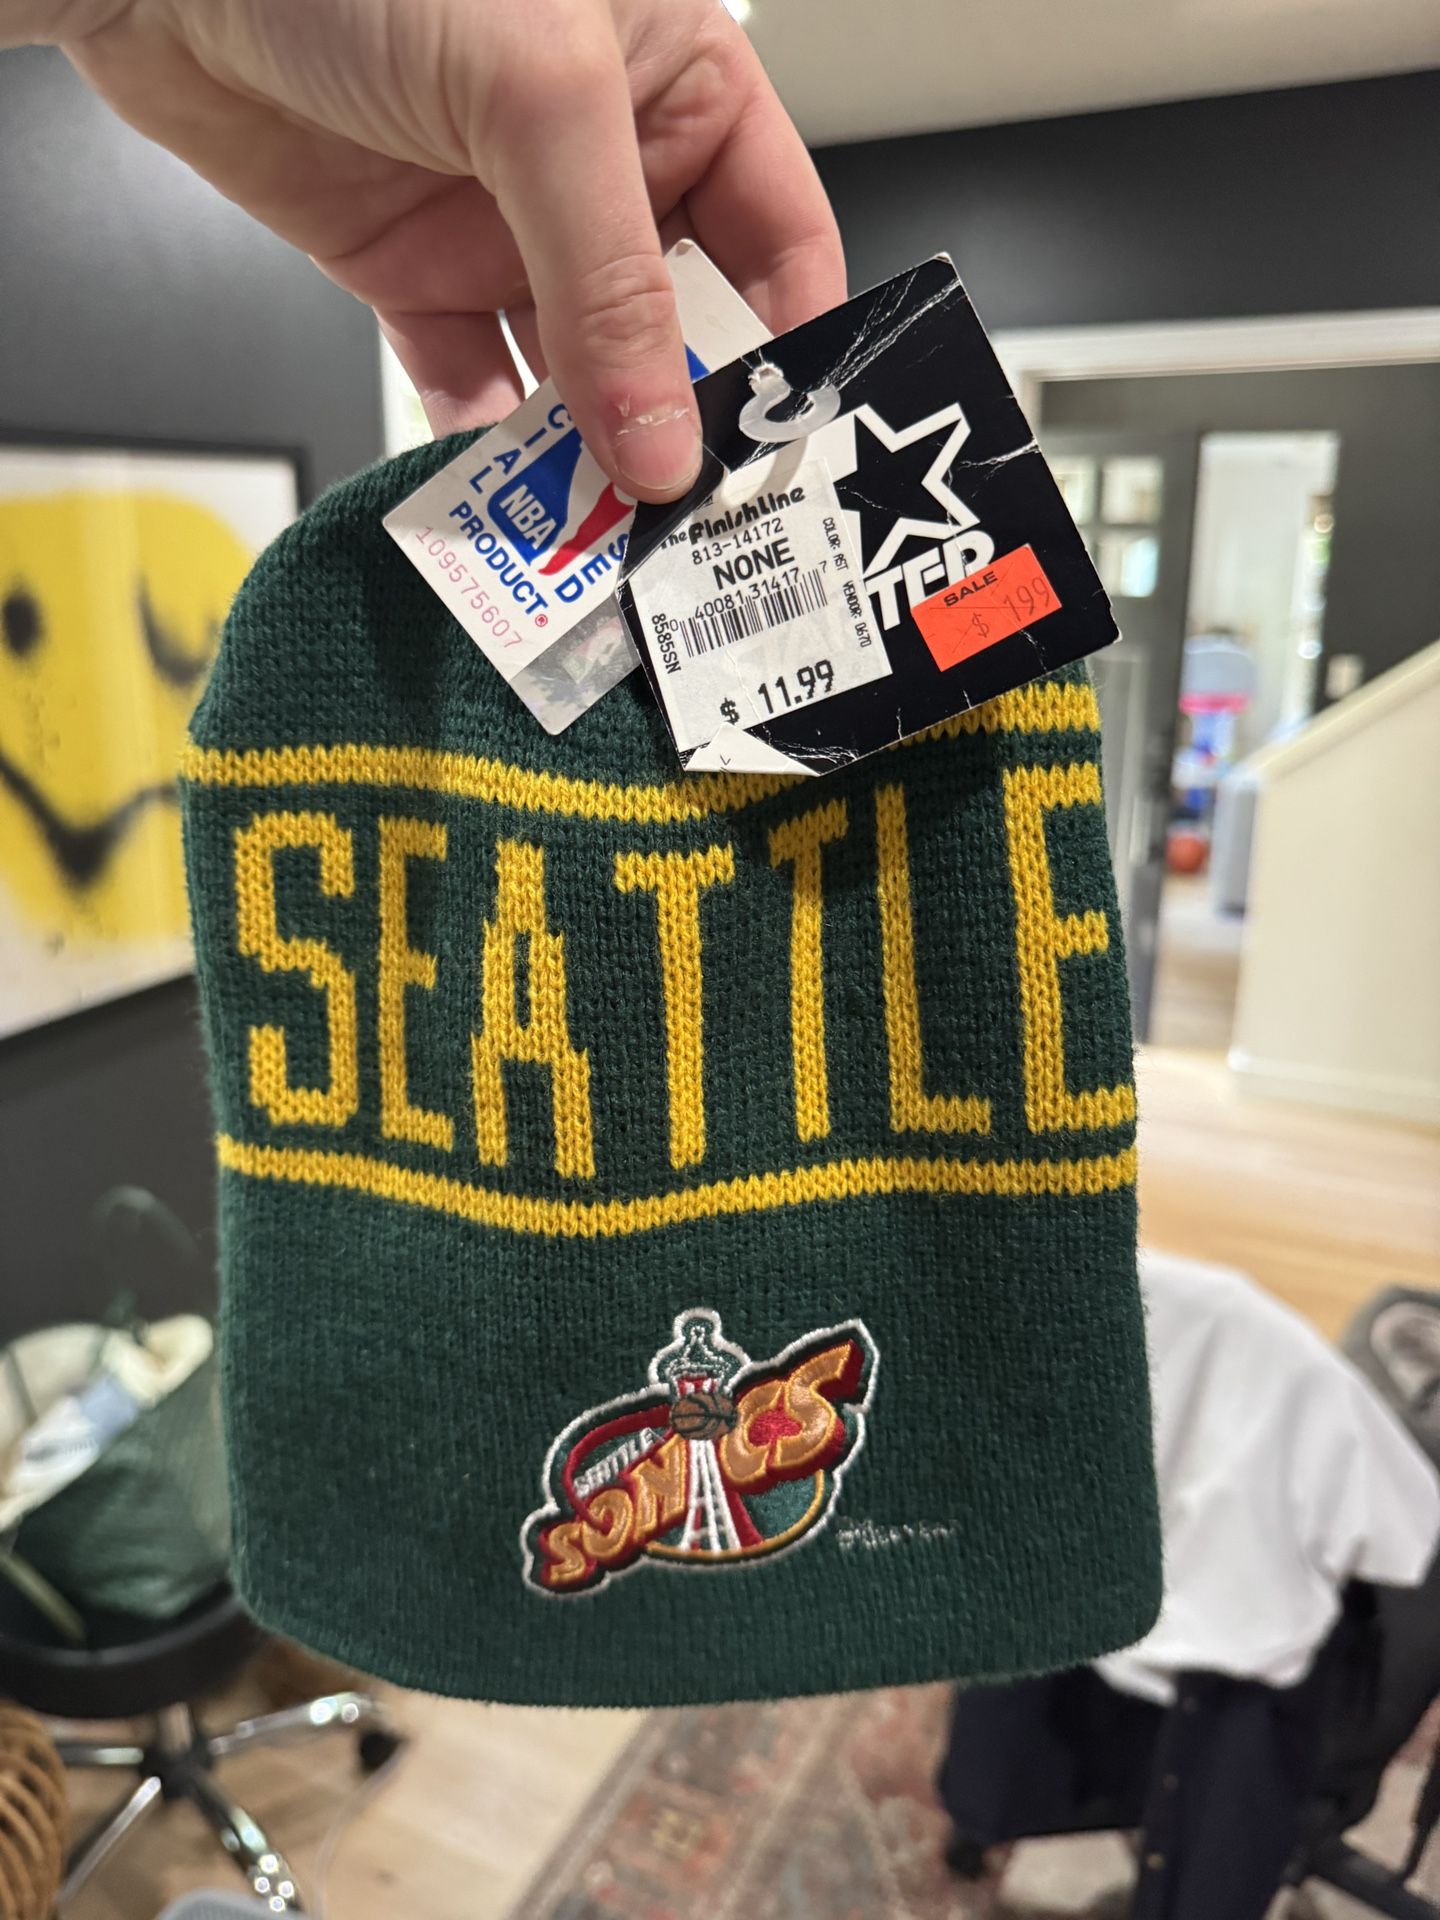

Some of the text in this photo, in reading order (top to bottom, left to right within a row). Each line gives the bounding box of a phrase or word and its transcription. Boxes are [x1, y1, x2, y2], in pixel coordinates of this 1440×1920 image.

[499, 483, 558, 551] NBA
[691, 516, 785, 566] 813-14172
[415, 525, 523, 650] 109575607
[712, 536, 796, 591] NONE
[822, 516, 841, 550] COLOR:
[842, 580, 862, 619] VENDOR:
[854, 622, 873, 648] 0670
[943, 570, 1000, 608] SALE
[651, 612, 682, 675] 8585SN
[757, 658, 835, 714] 11.99
[234, 762, 1137, 1178] SEATTLE
[547, 1339, 853, 1584] SONICS
[573, 1427, 657, 1499] SEATTLE
